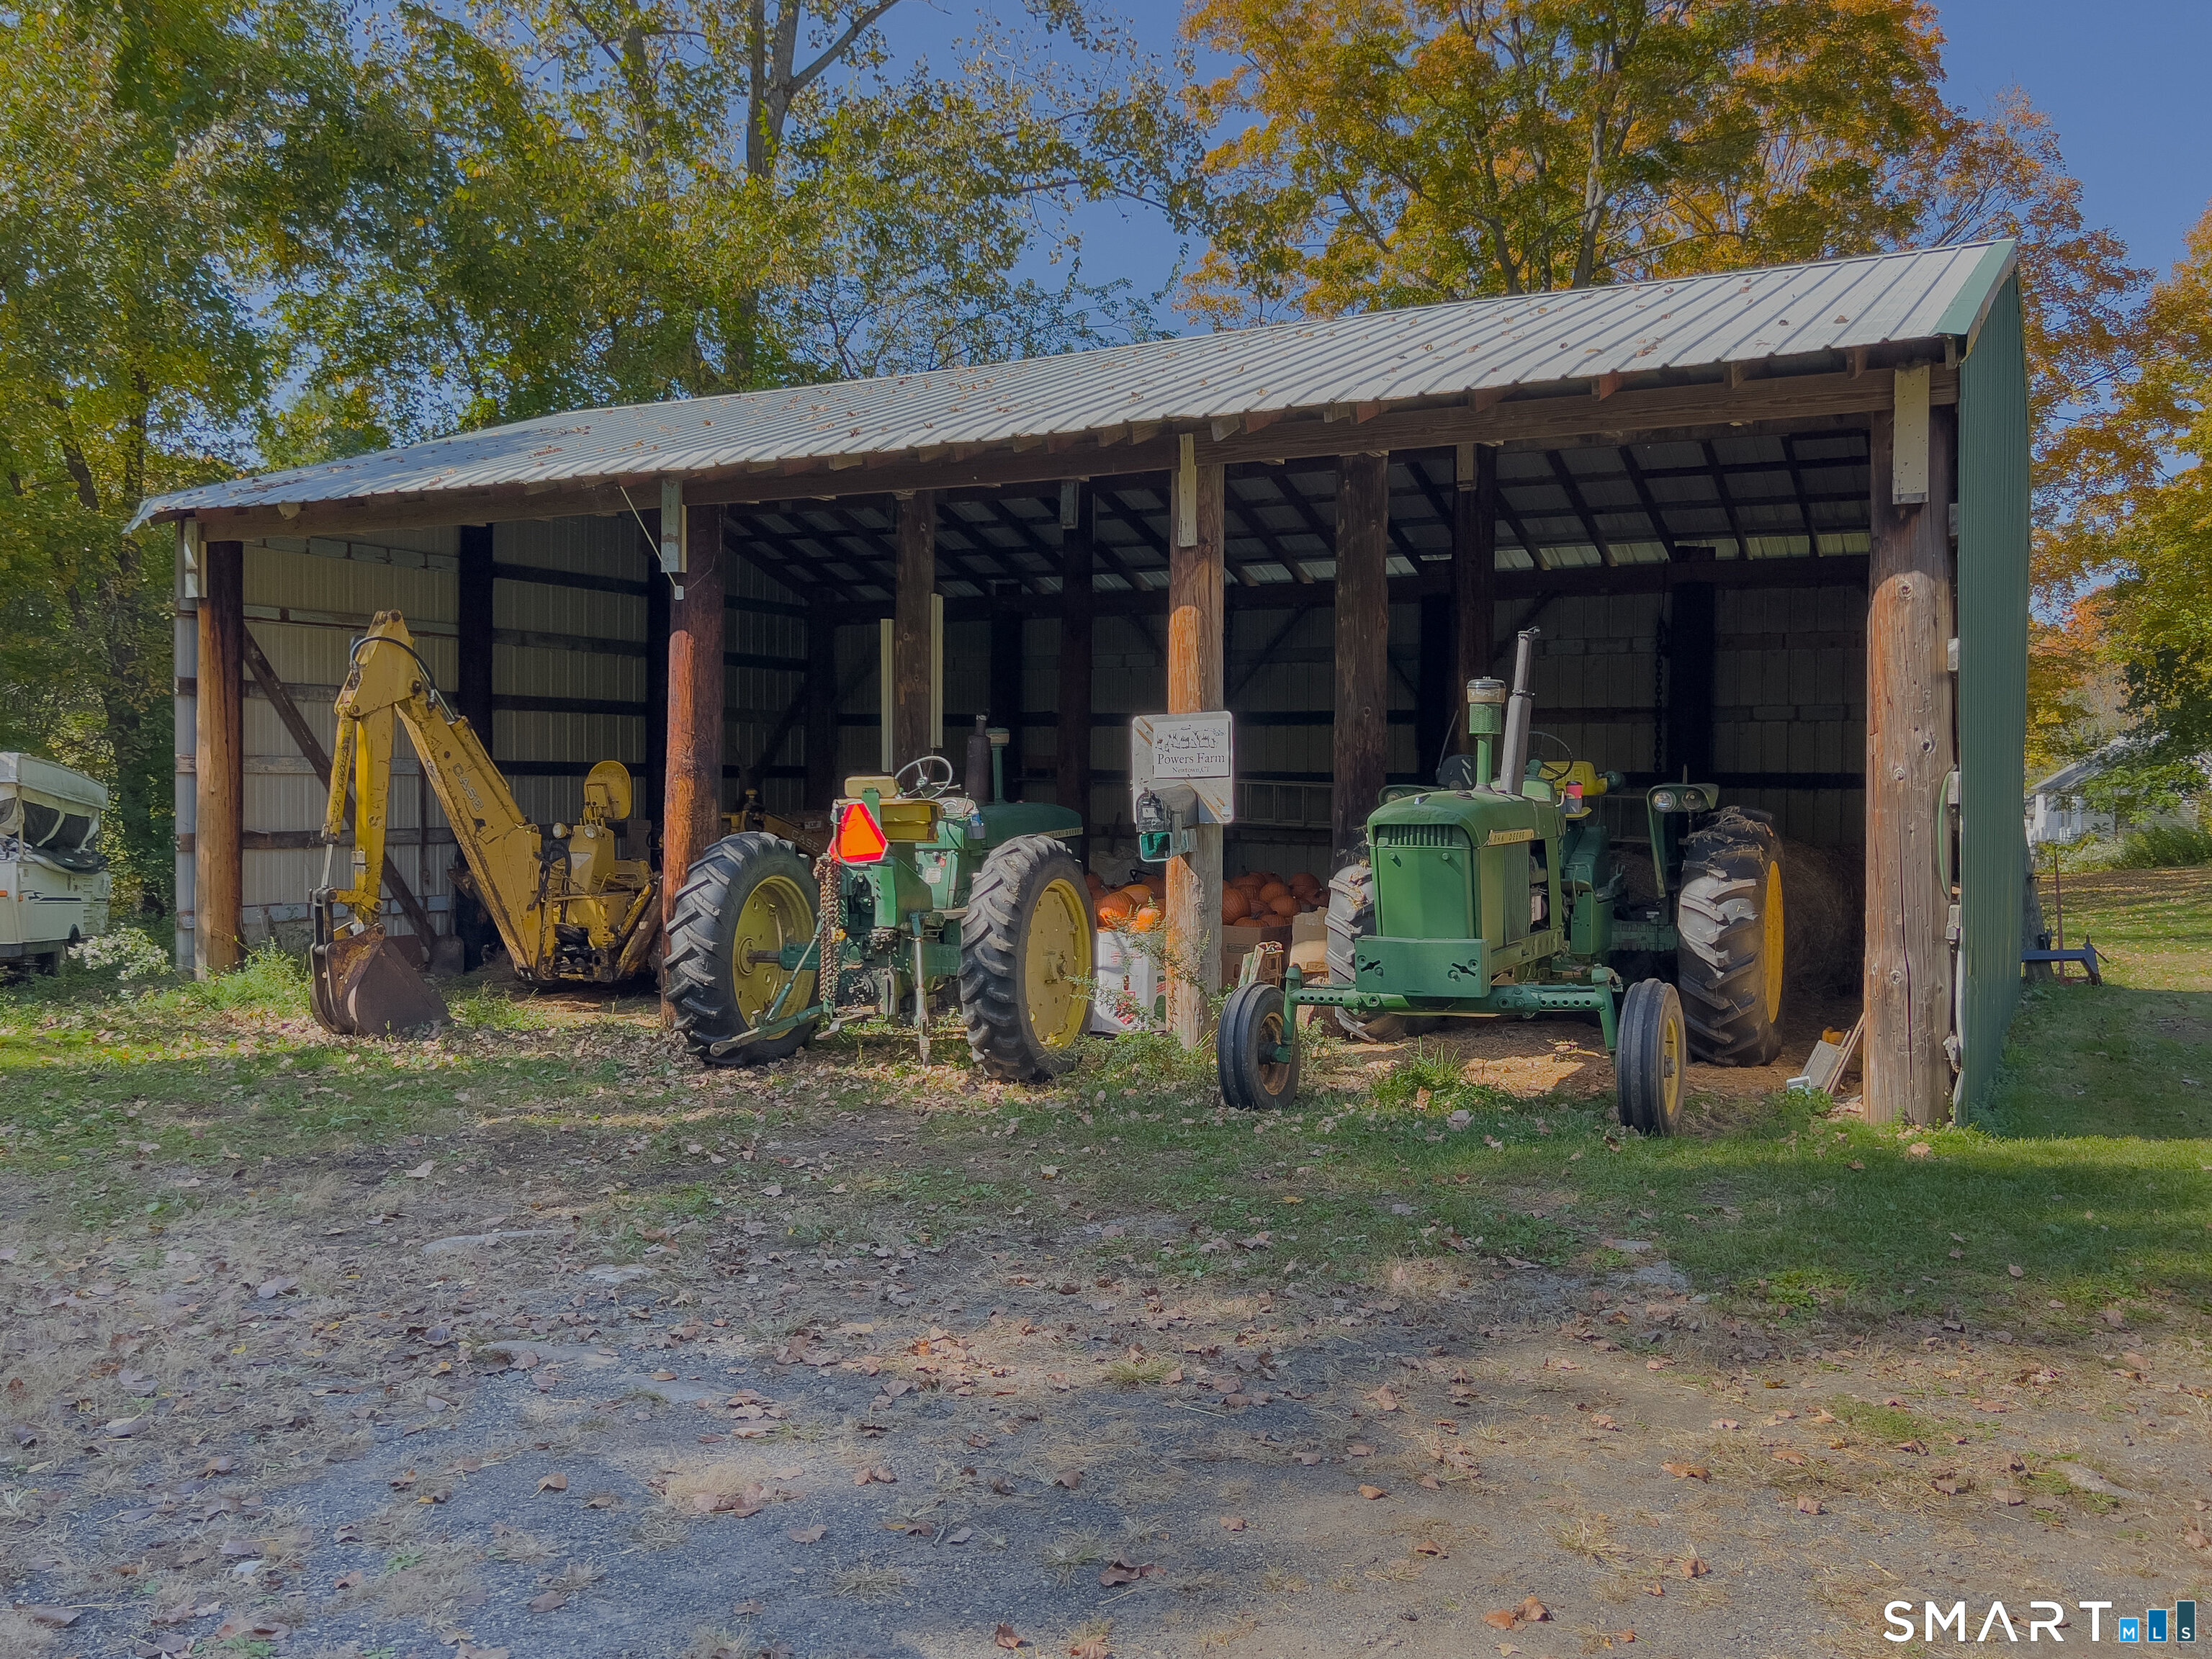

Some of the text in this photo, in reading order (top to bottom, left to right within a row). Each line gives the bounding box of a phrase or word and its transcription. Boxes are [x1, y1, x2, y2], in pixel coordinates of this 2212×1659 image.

[1157, 752, 1225, 765] Powers Farm
[453, 763, 484, 812] CASE
[792, 830, 819, 853] CASE
